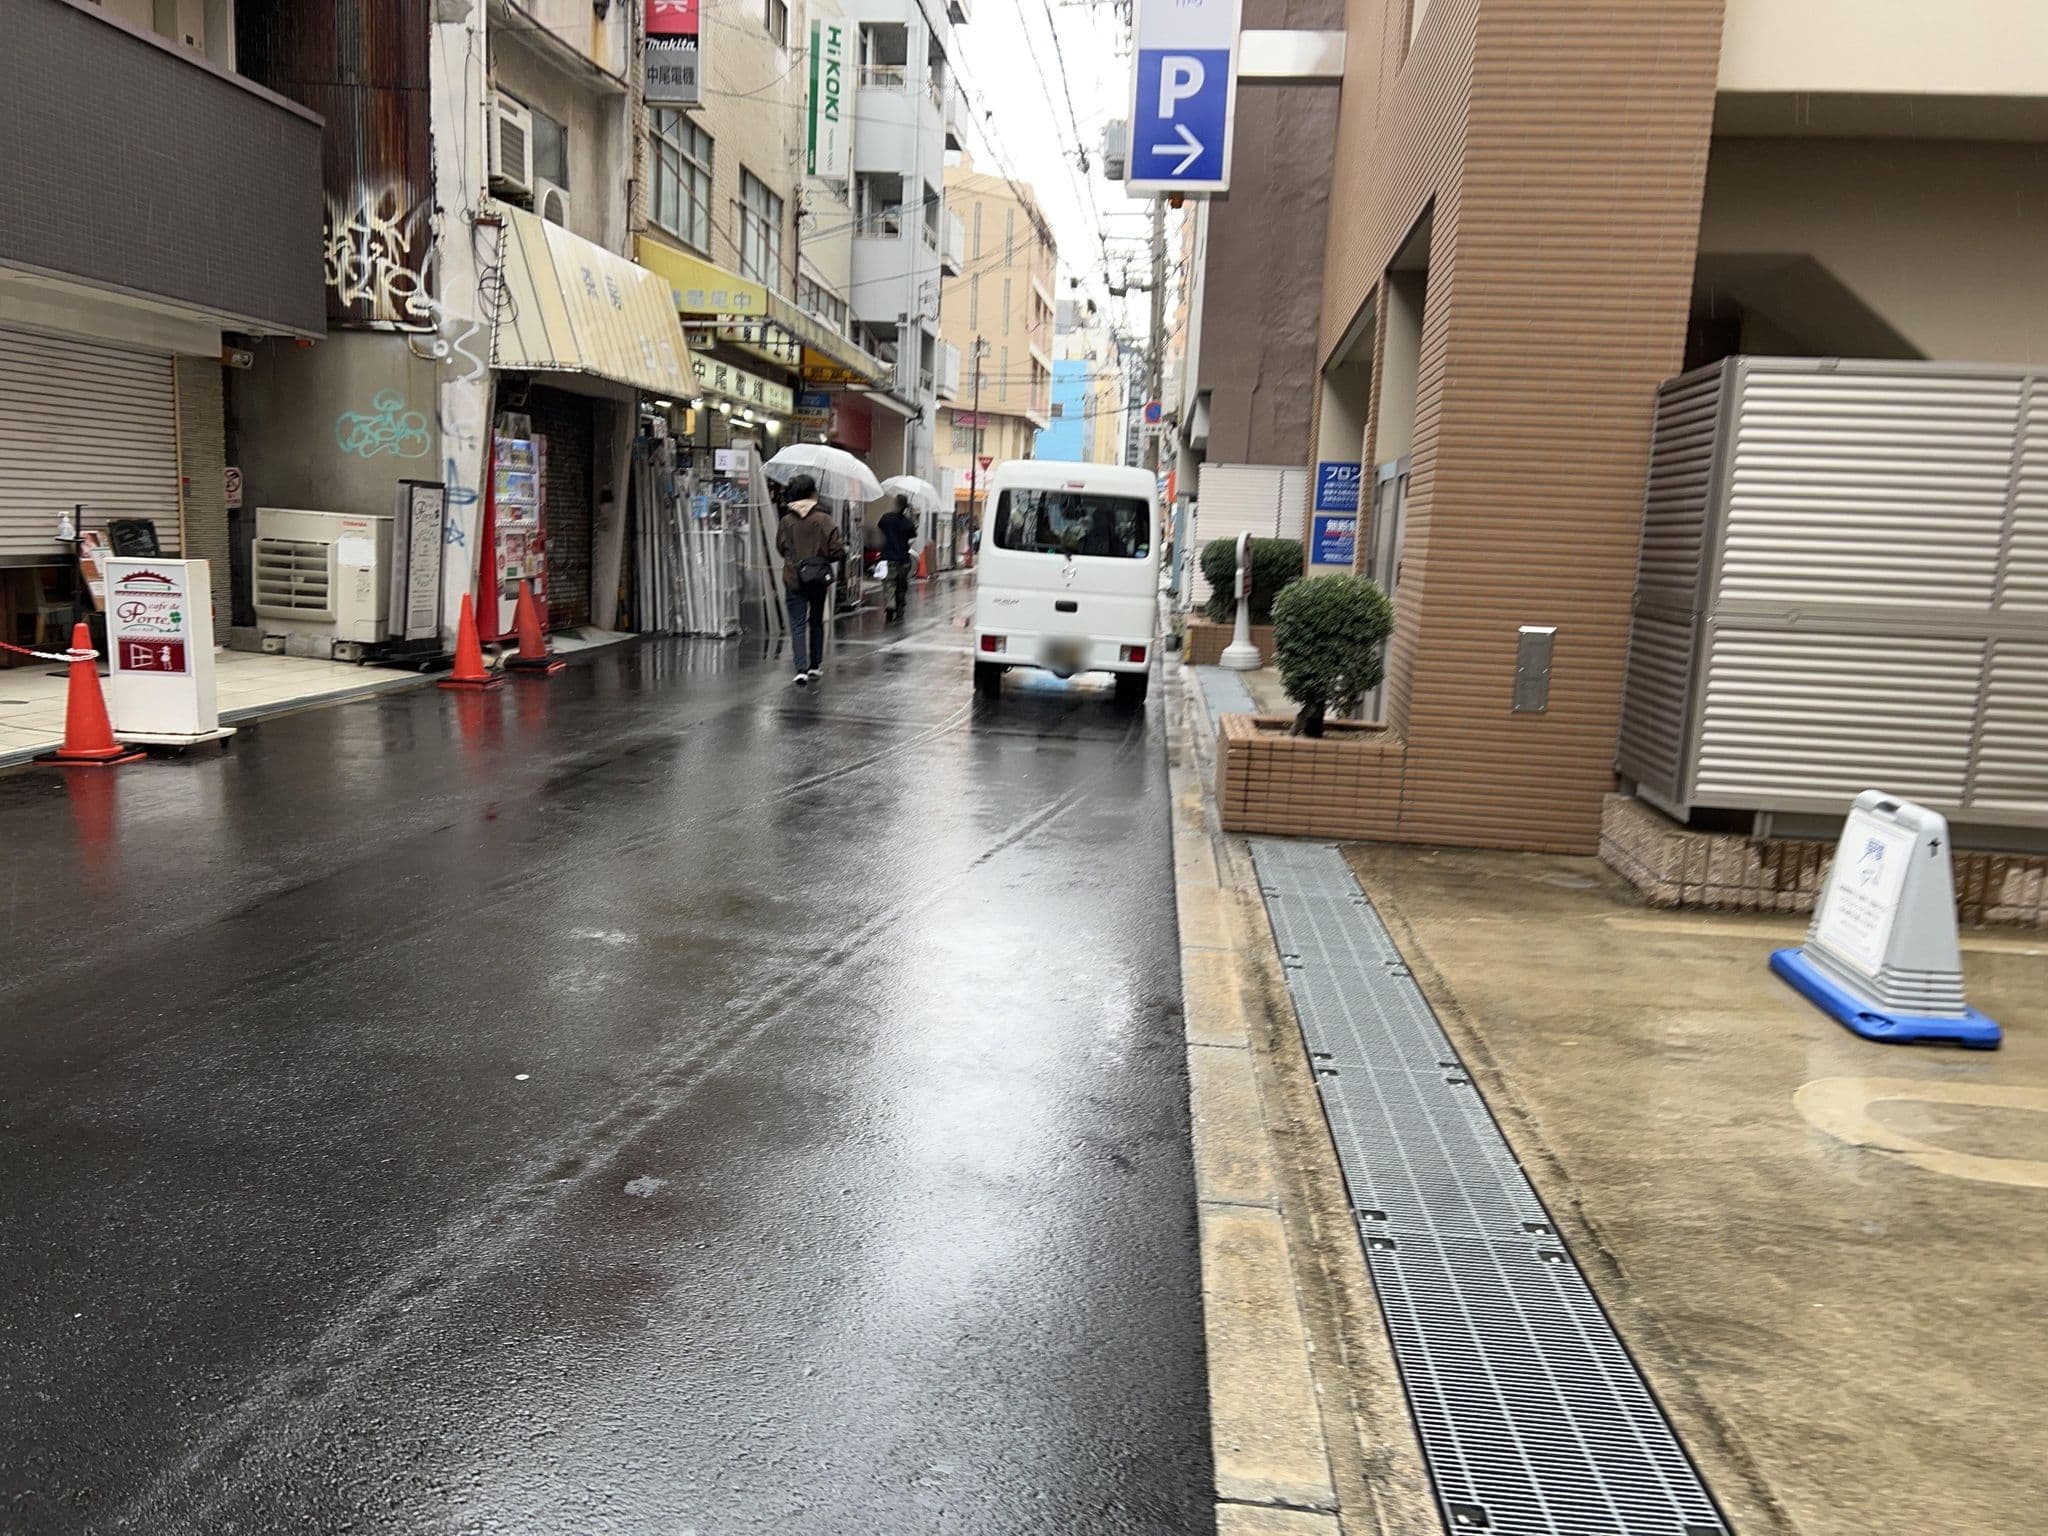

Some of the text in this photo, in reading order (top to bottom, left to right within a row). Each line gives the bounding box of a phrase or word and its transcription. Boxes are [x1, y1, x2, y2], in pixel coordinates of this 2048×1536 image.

[647, 64, 695, 86] 中尾電機
[1158, 55, 1205, 119] P
